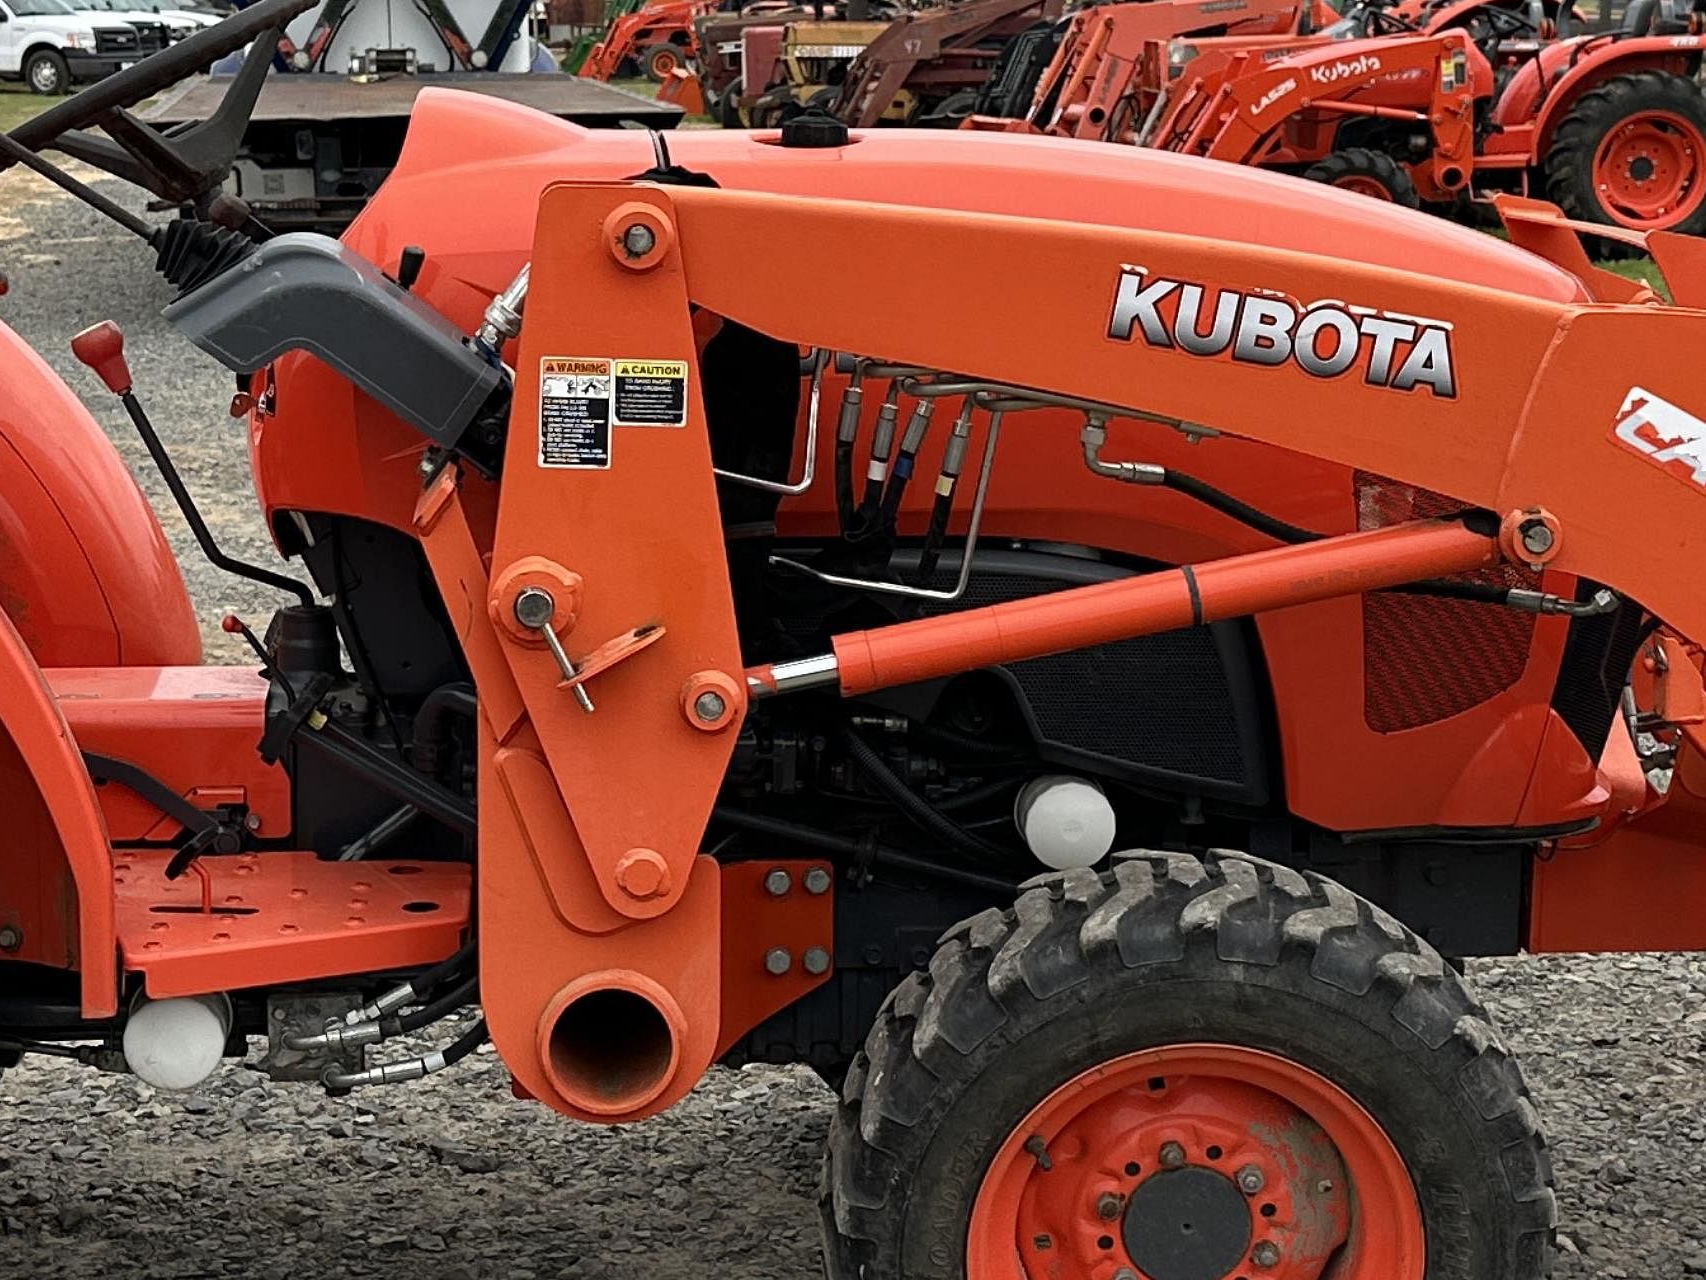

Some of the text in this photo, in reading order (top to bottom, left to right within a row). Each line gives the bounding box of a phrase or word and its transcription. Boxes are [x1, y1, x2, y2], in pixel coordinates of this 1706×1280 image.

[1311, 55, 1381, 83] Kubota
[1108, 269, 1457, 399] KUBOTA
[556, 362, 607, 374] WARNING
[631, 365, 681, 375] CAUTION
